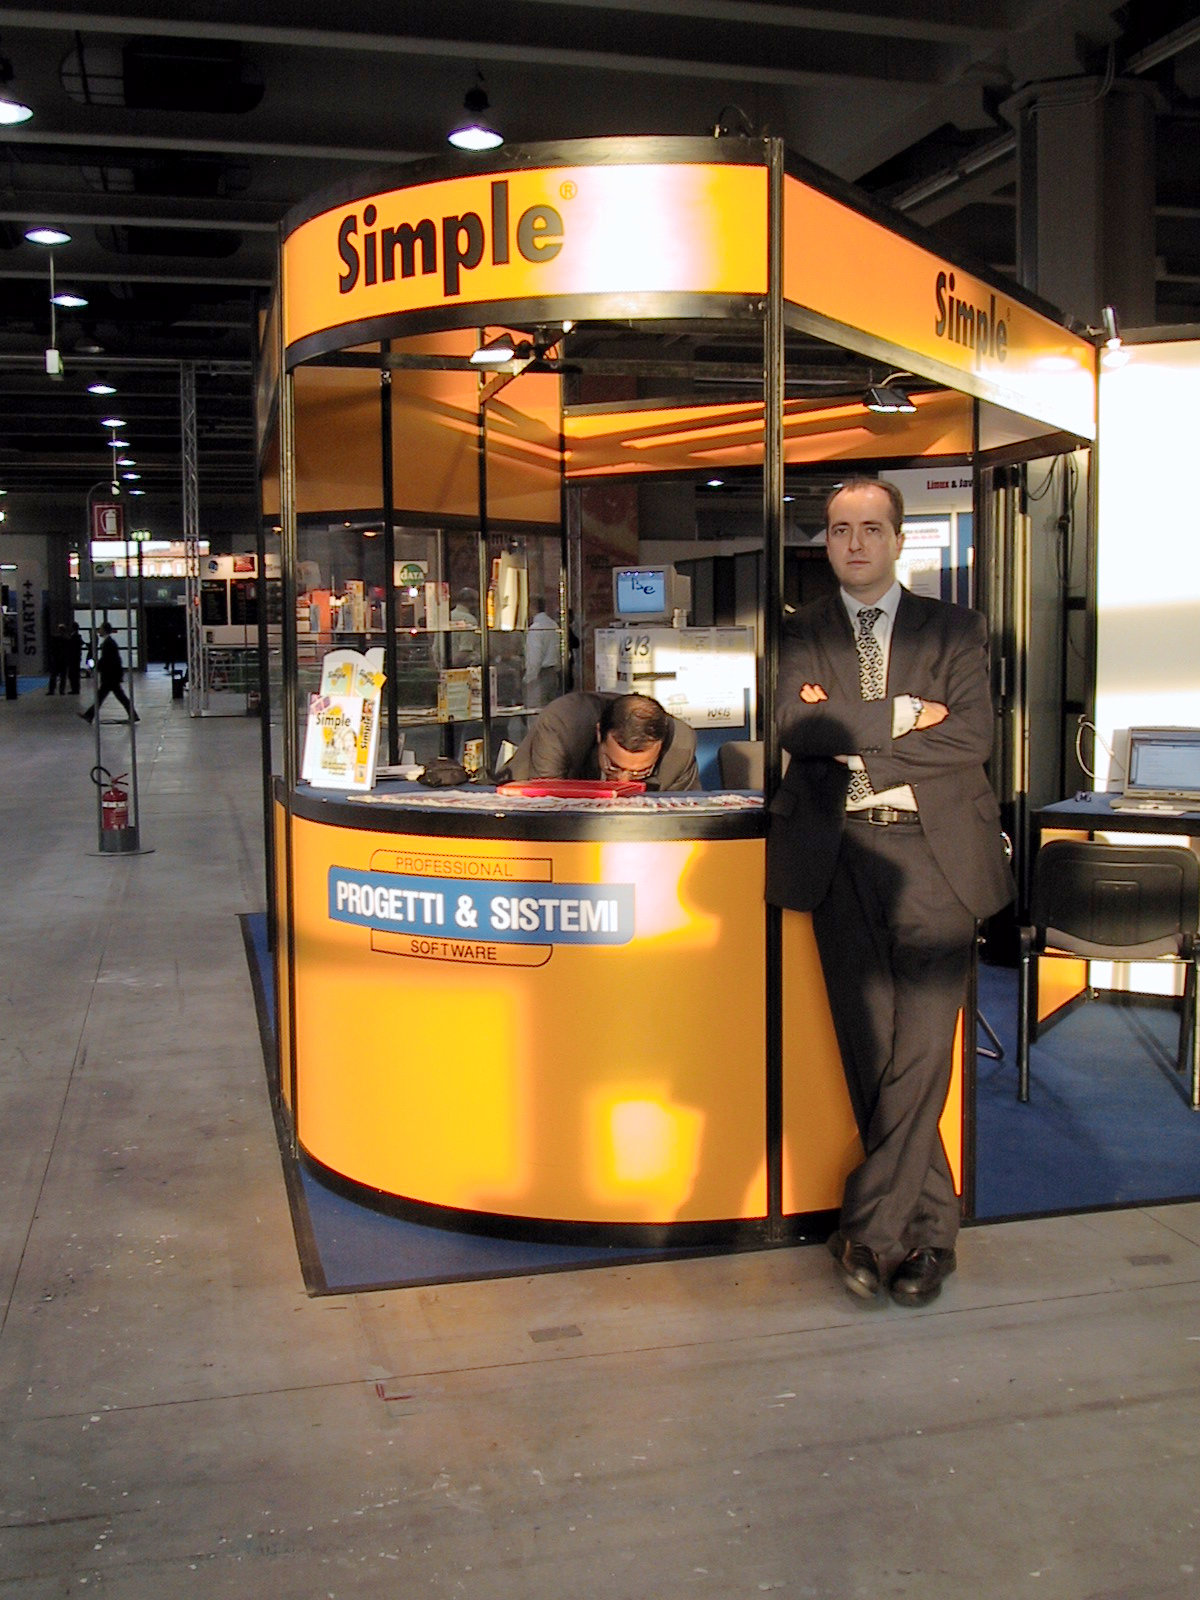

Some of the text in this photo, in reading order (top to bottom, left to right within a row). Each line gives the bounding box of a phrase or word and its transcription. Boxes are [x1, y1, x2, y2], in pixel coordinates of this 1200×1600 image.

[935, 271, 1008, 371] Simple
[23, 579, 37, 656] START++
[316, 713, 352, 730] Simple
[360, 715, 373, 750] Simple
[395, 856, 514, 878] PROFESSIONAL
[336, 880, 619, 933] PROGETTI & SISTEMI
[410, 939, 497, 960] SOFTWARE
